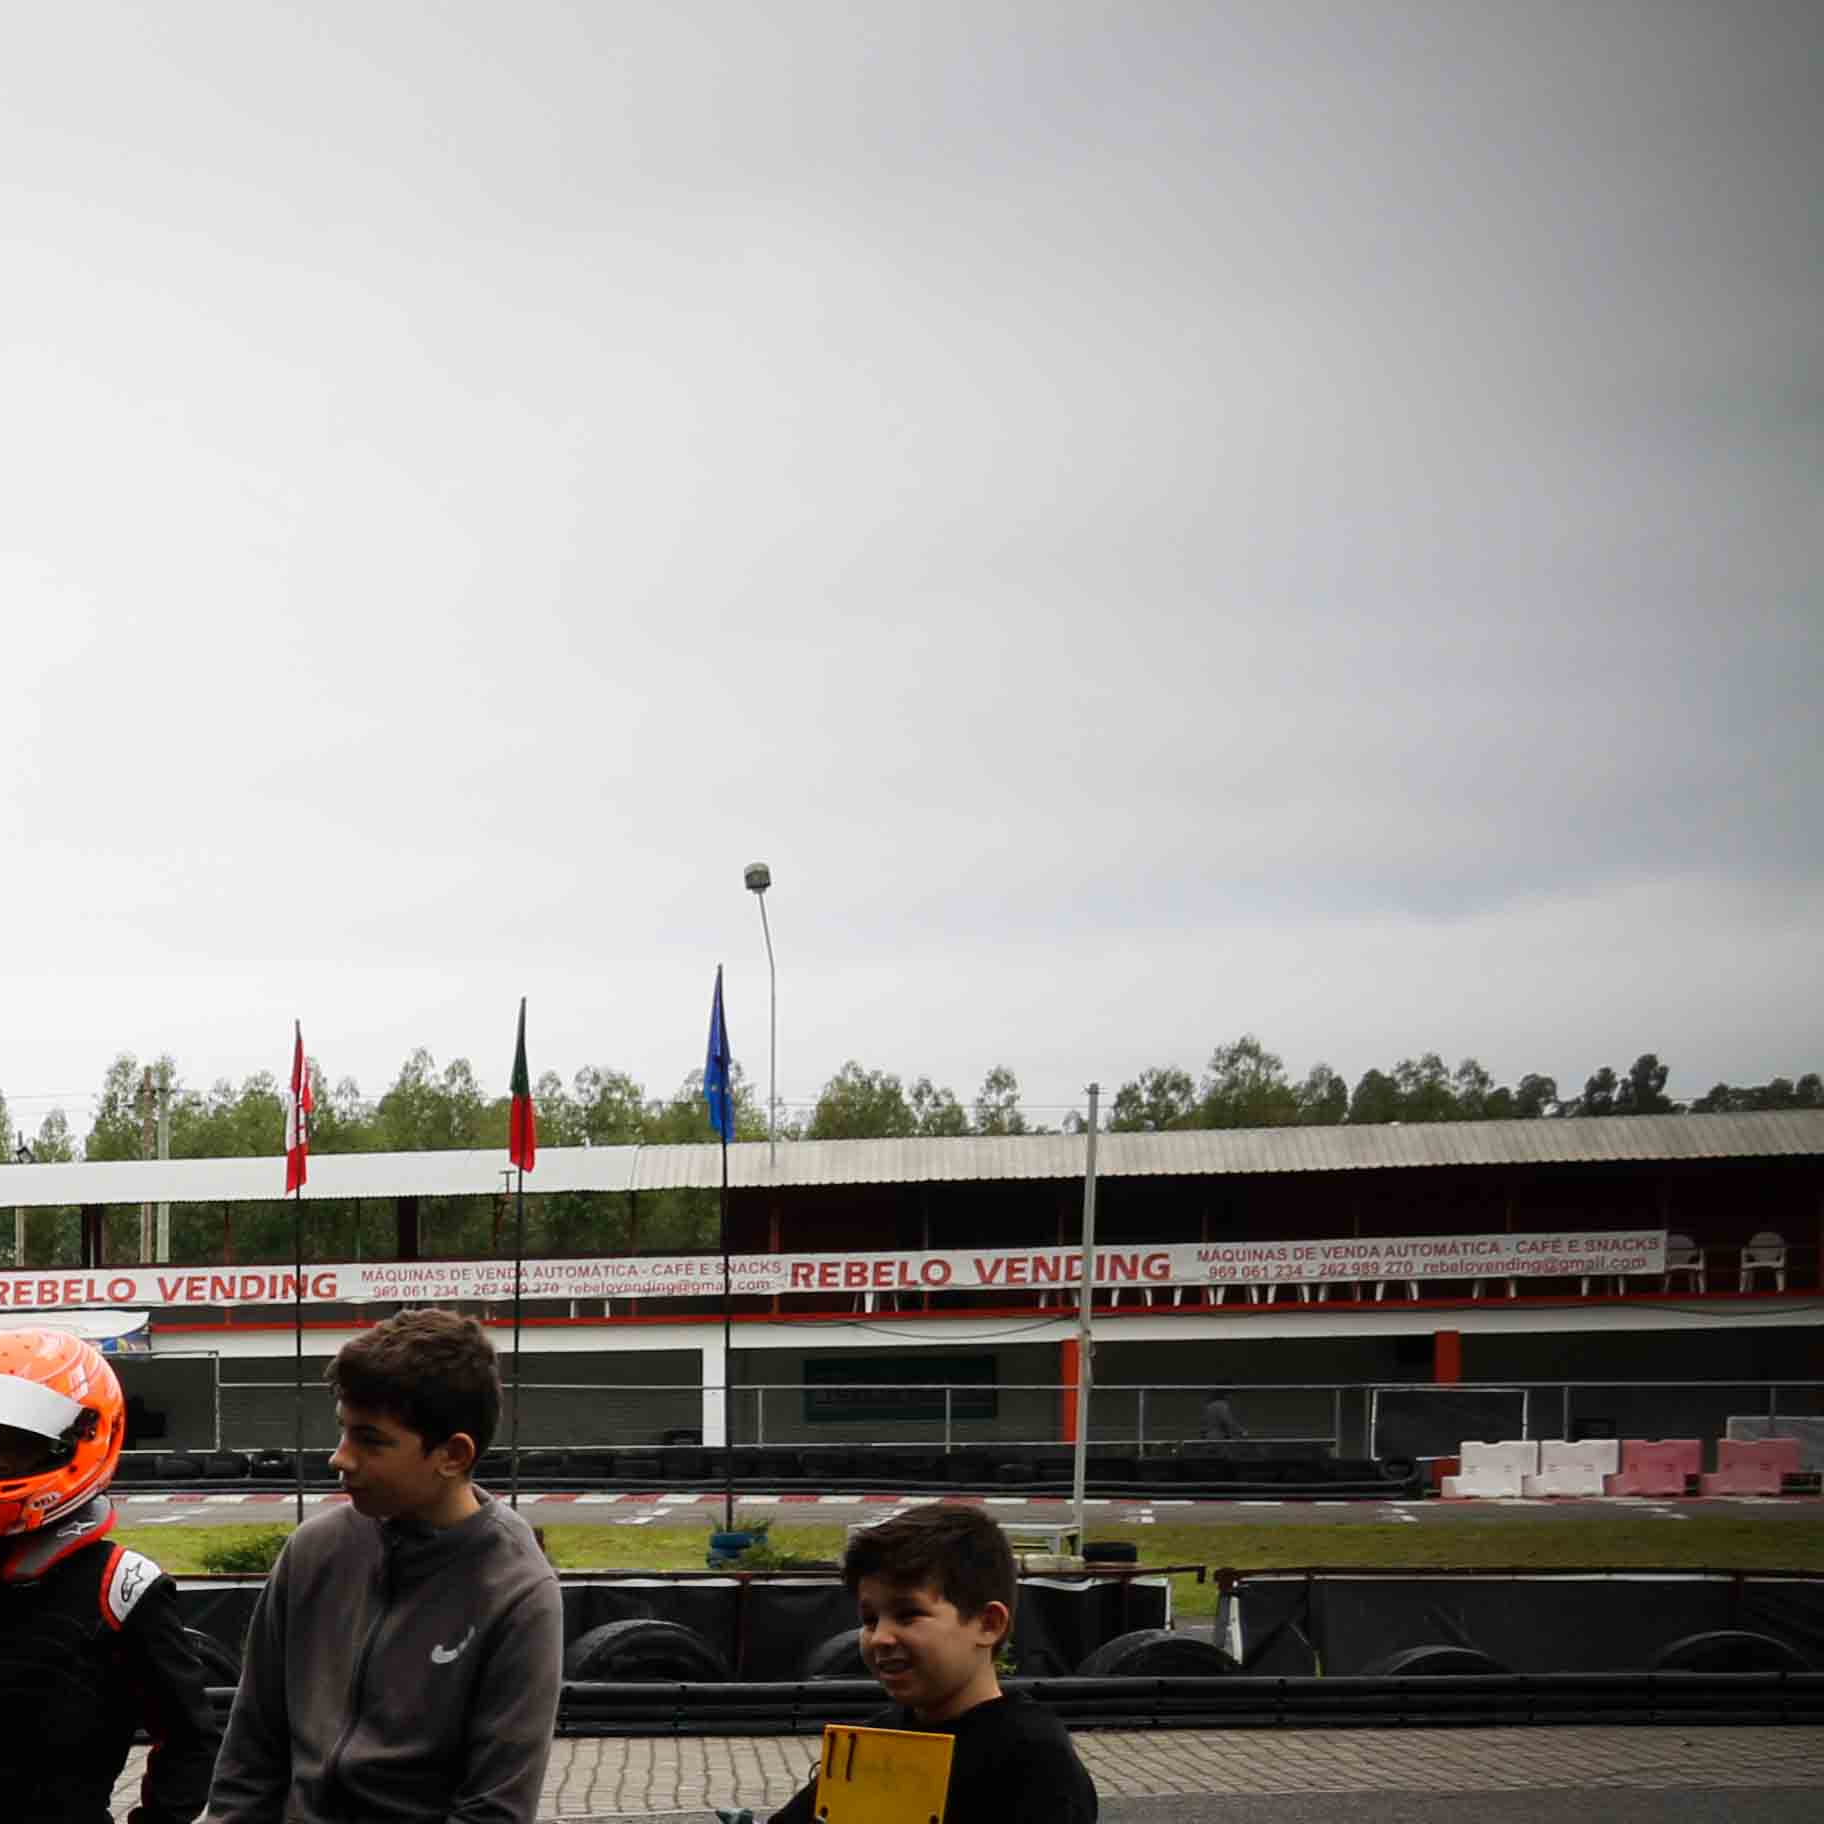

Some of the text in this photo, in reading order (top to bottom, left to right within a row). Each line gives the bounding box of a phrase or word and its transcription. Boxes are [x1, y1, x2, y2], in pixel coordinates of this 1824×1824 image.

[1293, 1248, 1316, 1260] DE
[1322, 1246, 1380, 1259] VENDA
[1516, 1239, 1562, 1254] CAFÉ
[1567, 1240, 1579, 1252] E
[1584, 1238, 1659, 1251] SNACKS
[451, 1269, 472, 1281] DE
[477, 1267, 529, 1280] VENDA
[533, 1264, 639, 1279] AUTOMÁTICA
[652, 1262, 694, 1276] CAFÉ
[699, 1263, 710, 1275] E
[715, 1261, 783, 1275] SNACKS
[791, 1253, 1172, 1288] REBELO VENDING
[156, 1272, 338, 1301] VENDING
[568, 1279, 770, 1296] rebelovending@gmal.com
